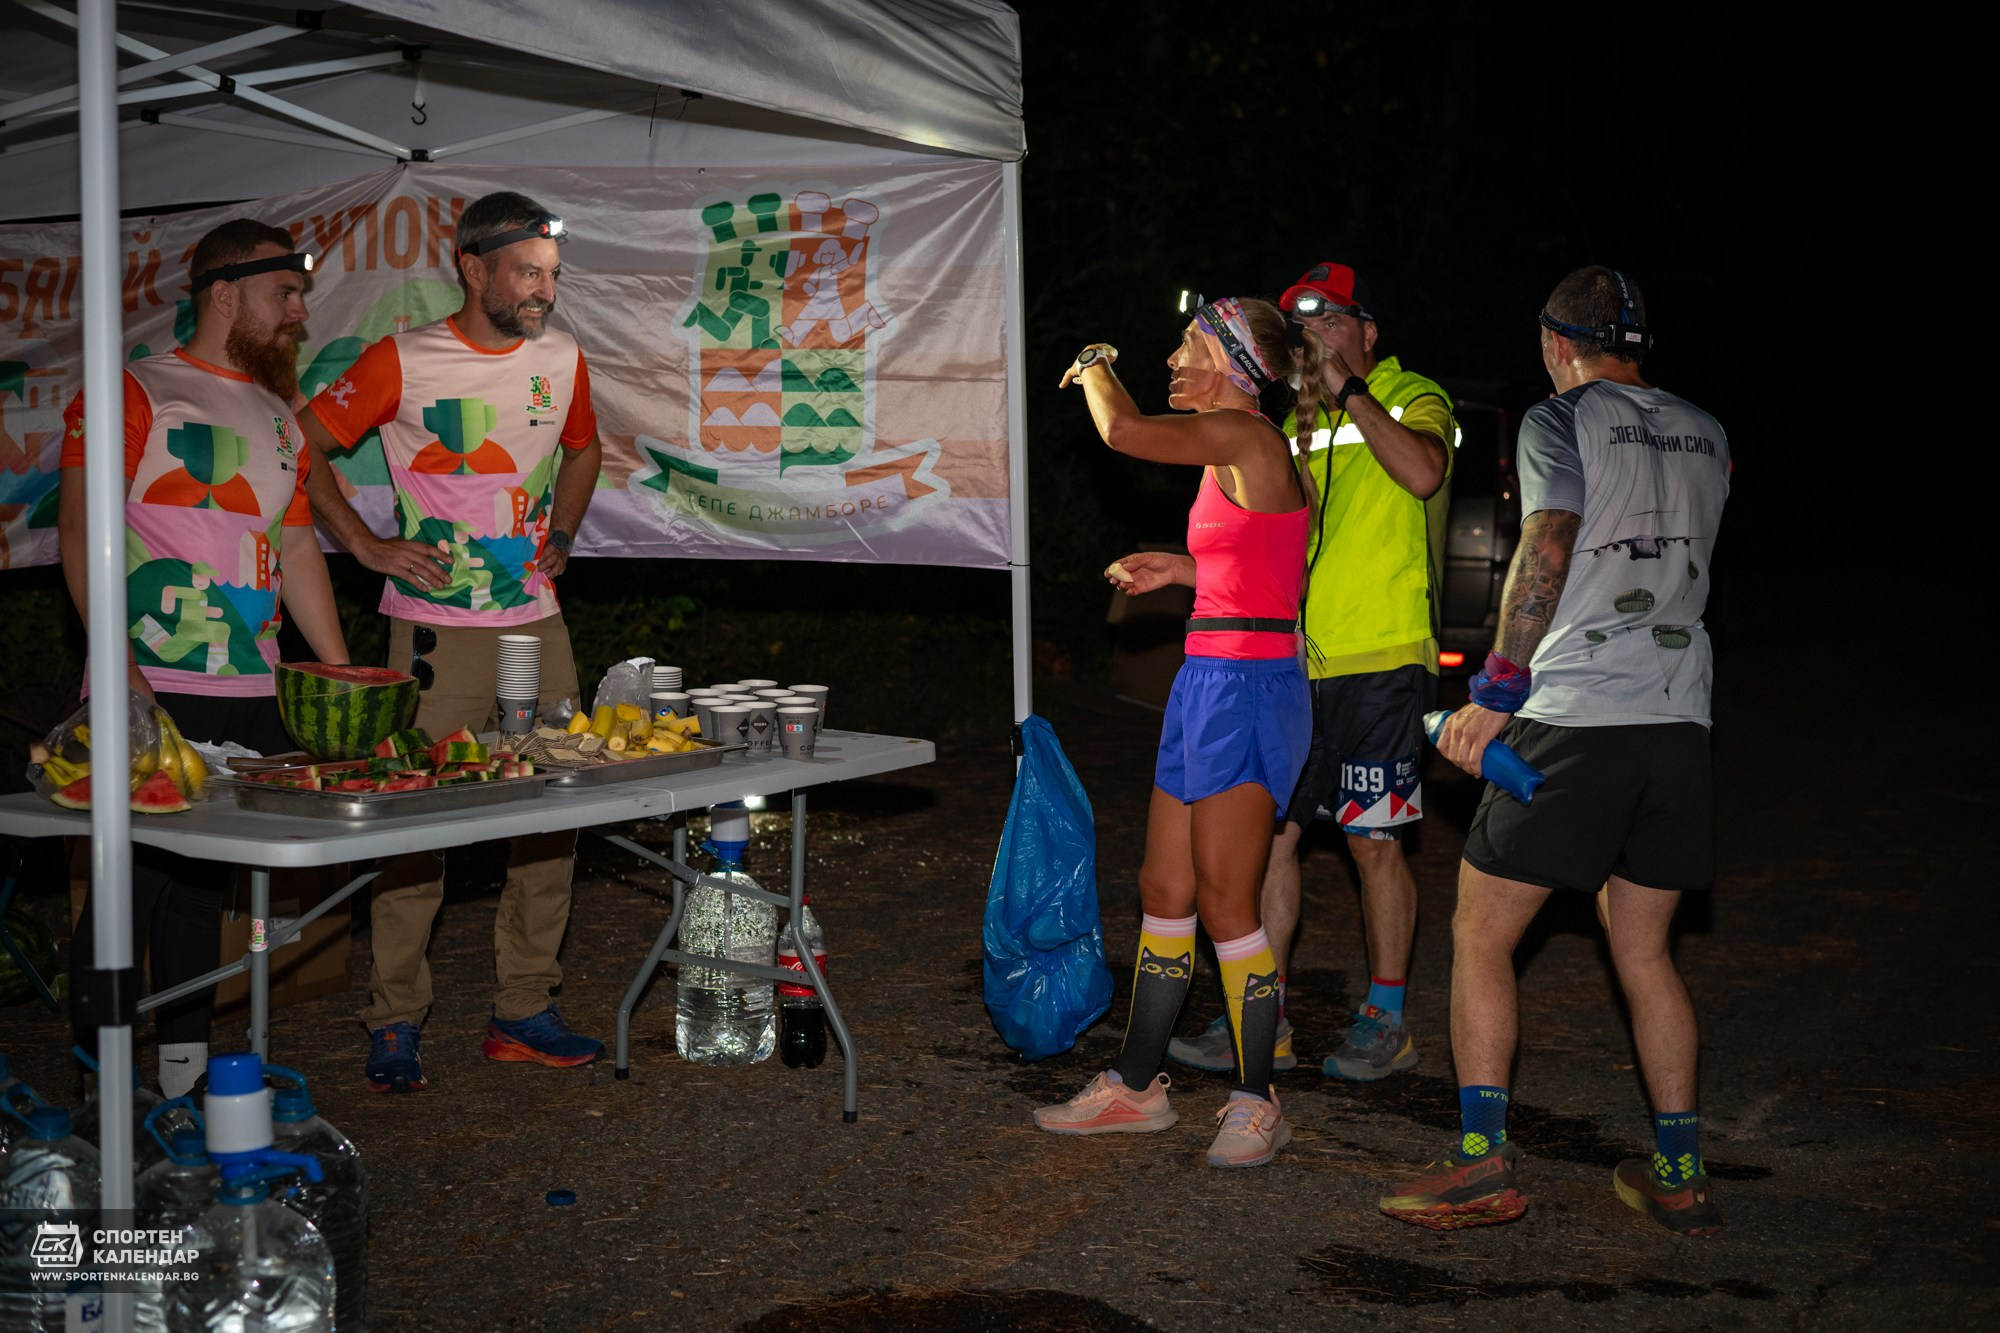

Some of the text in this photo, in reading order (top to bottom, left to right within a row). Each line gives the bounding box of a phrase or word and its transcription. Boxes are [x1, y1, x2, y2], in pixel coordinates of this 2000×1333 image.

[0, 230, 165, 323] БЯГЙ
[289, 195, 465, 276] УПОН
[1239, 353, 1262, 379] HEADLAMP
[1684, 435, 1716, 459] СИЛИ
[685, 489, 889, 522] ТЕПЕ ДЖАМБОРЕ
[1479, 1090, 1500, 1099] TRY
[1658, 1119, 1677, 1127] TRY
